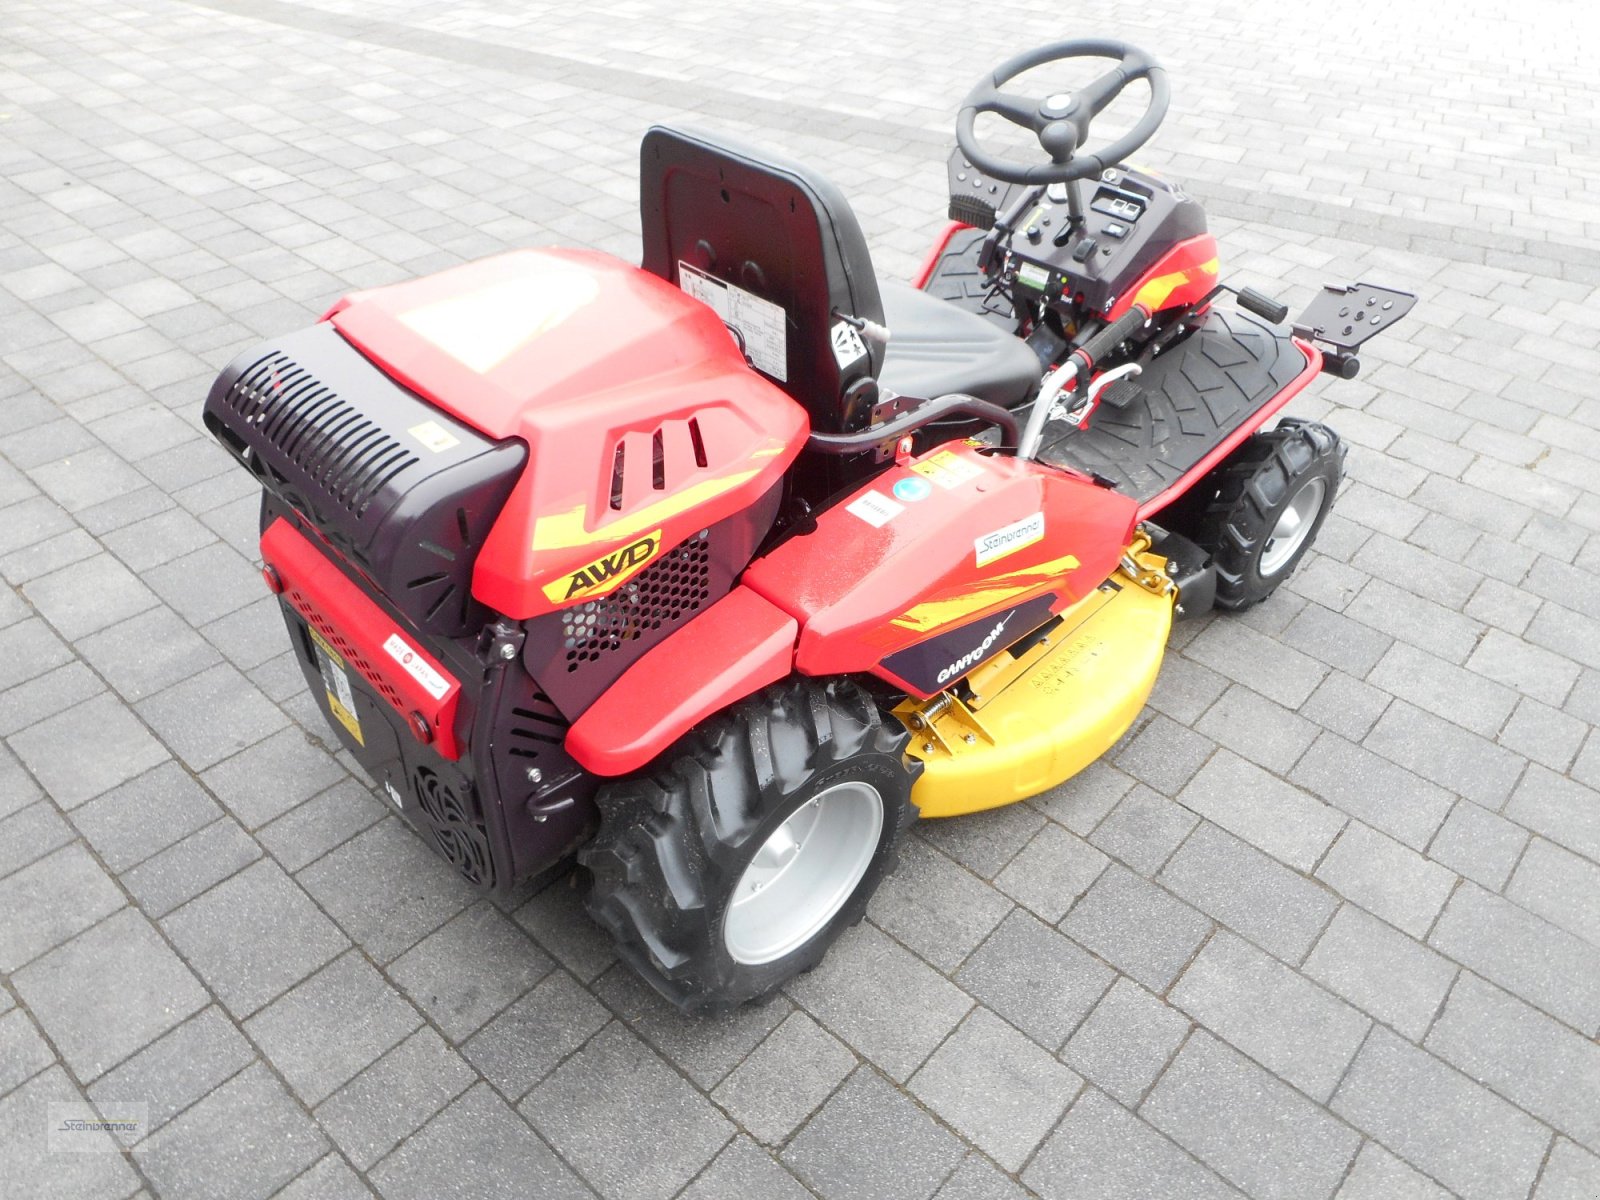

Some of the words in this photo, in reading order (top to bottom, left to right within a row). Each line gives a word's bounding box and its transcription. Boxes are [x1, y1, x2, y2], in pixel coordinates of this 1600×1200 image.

[979, 519, 1040, 554] Steinbrenner
[564, 538, 655, 600] AWD
[937, 620, 1006, 684] CANYCOM
